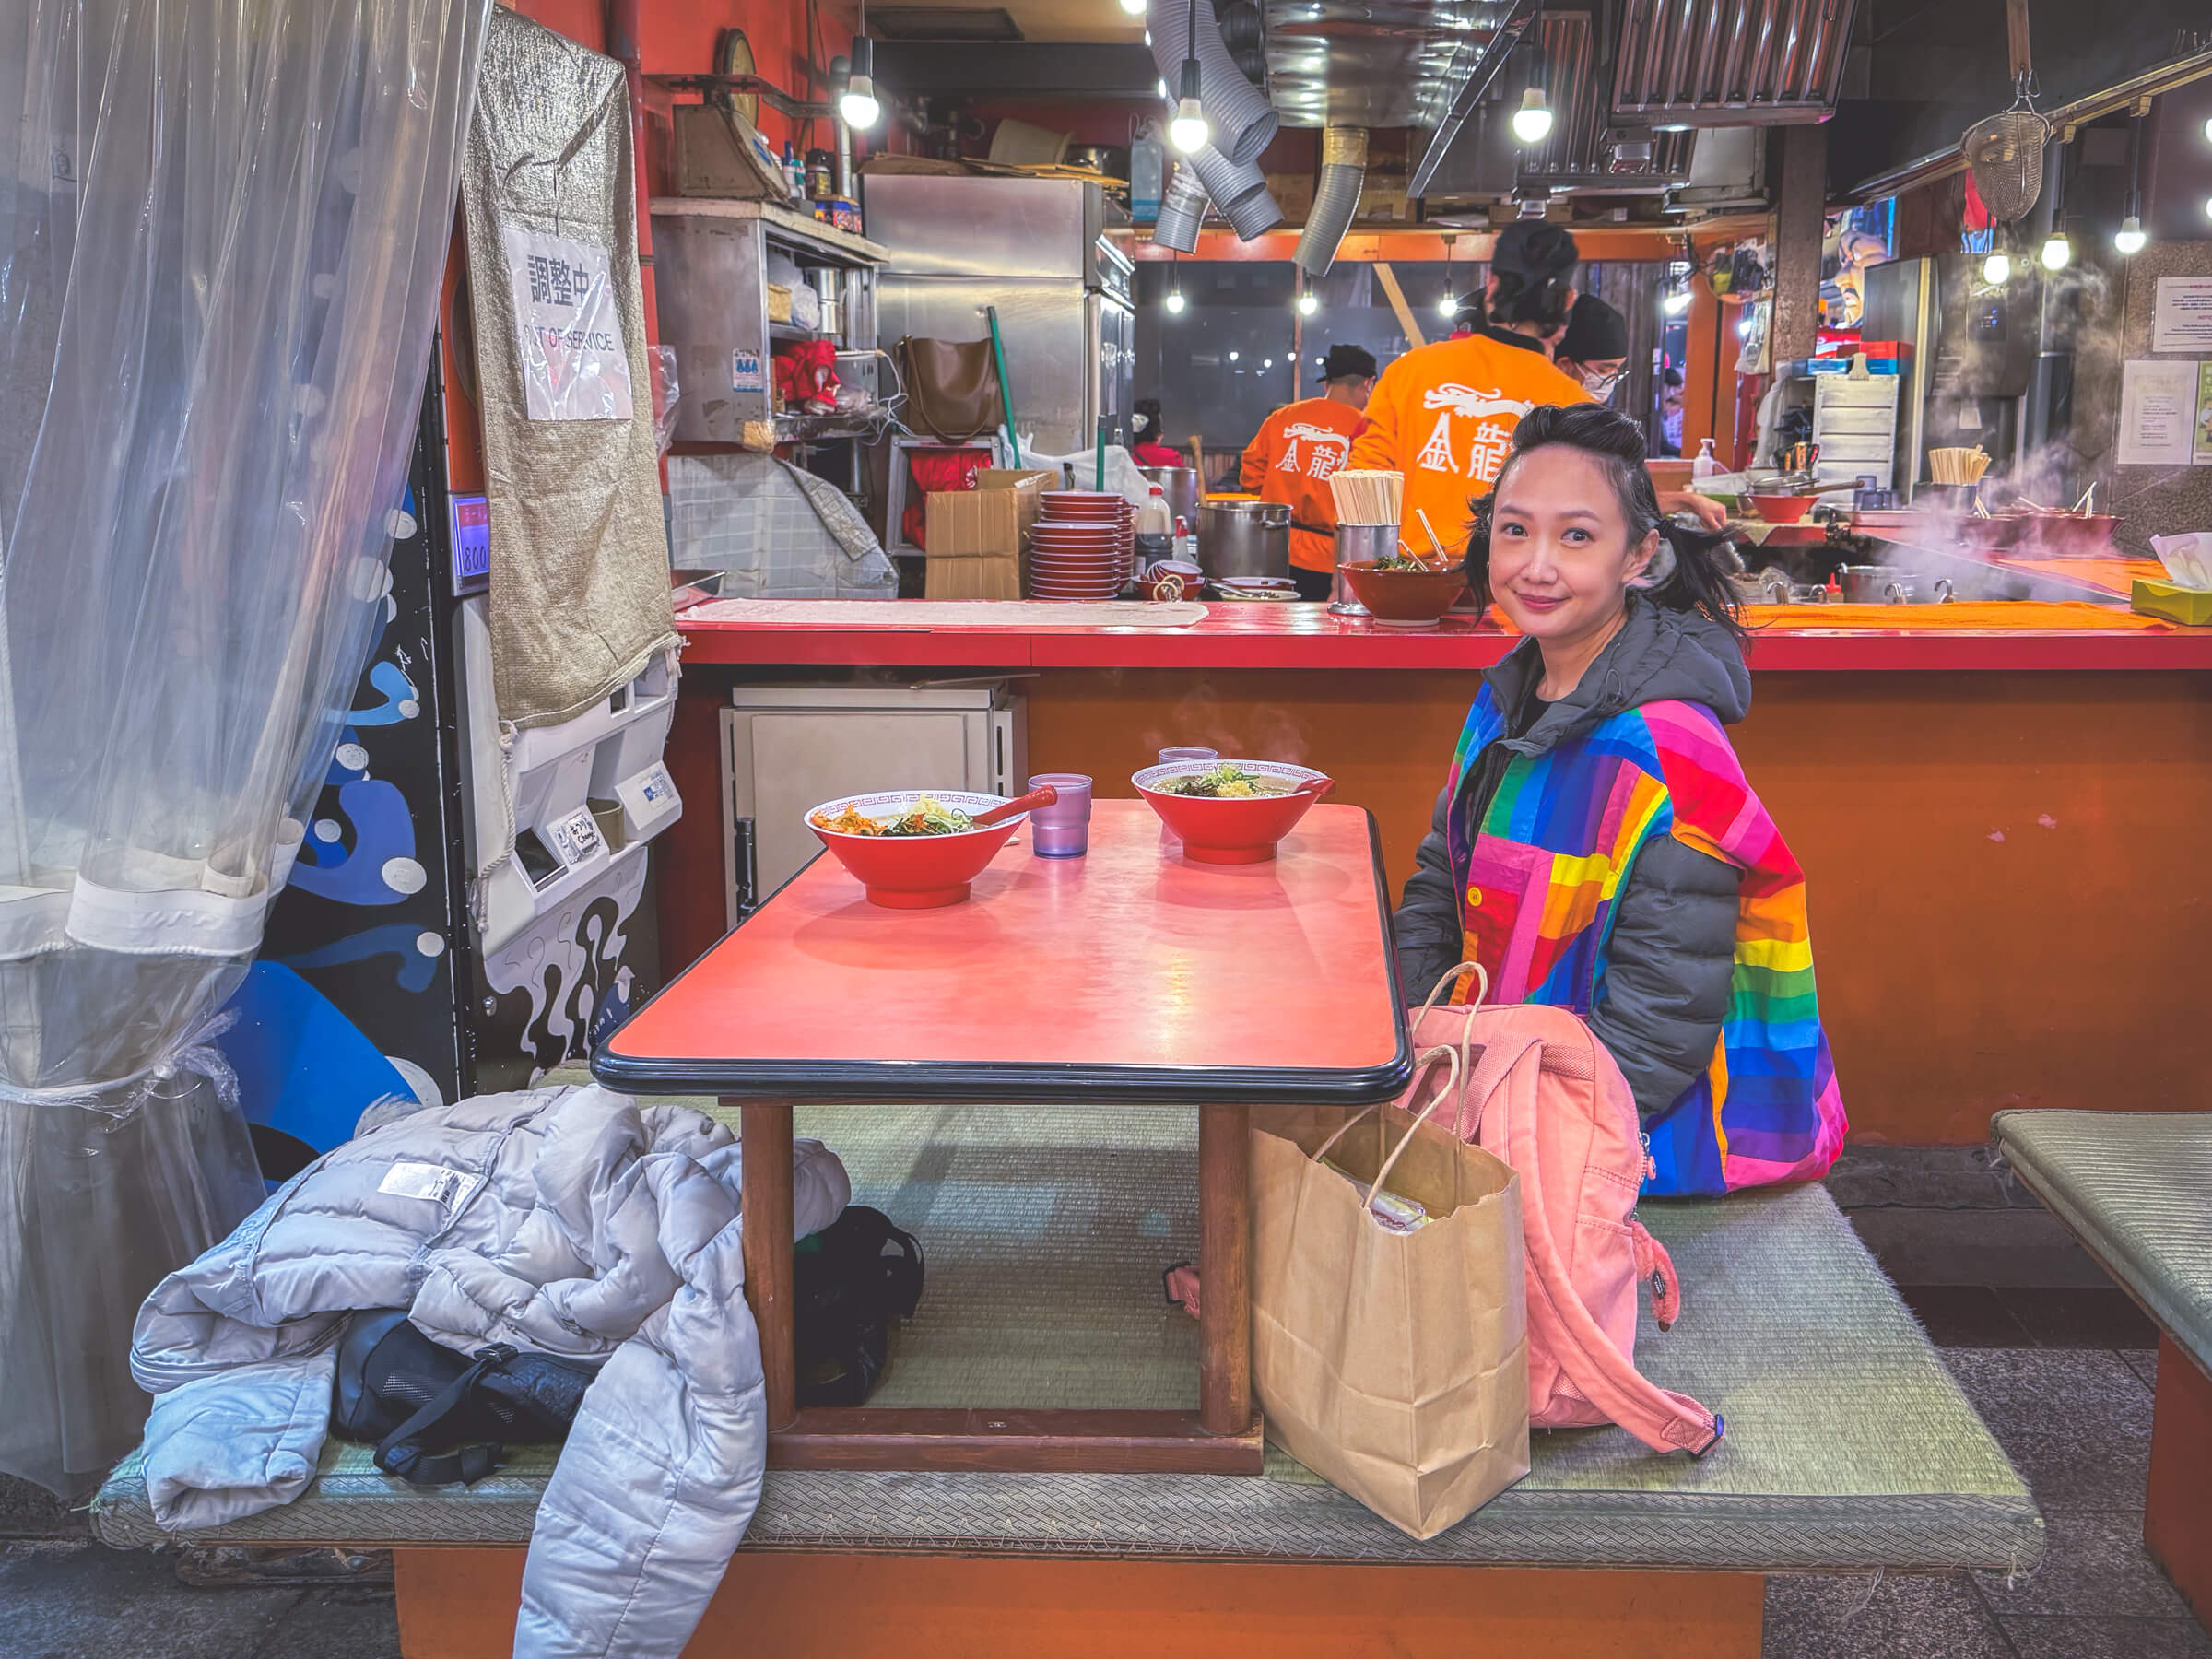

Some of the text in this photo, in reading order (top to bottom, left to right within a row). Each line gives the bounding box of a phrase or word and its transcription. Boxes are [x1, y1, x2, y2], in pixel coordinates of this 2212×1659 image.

[527, 254, 590, 309] 調整中
[548, 326, 566, 348] OF
[566, 330, 614, 351] SERVICE
[1276, 439, 1339, 481] 金龍
[1416, 411, 1512, 483] 金龍
[465, 546, 487, 571] 800
